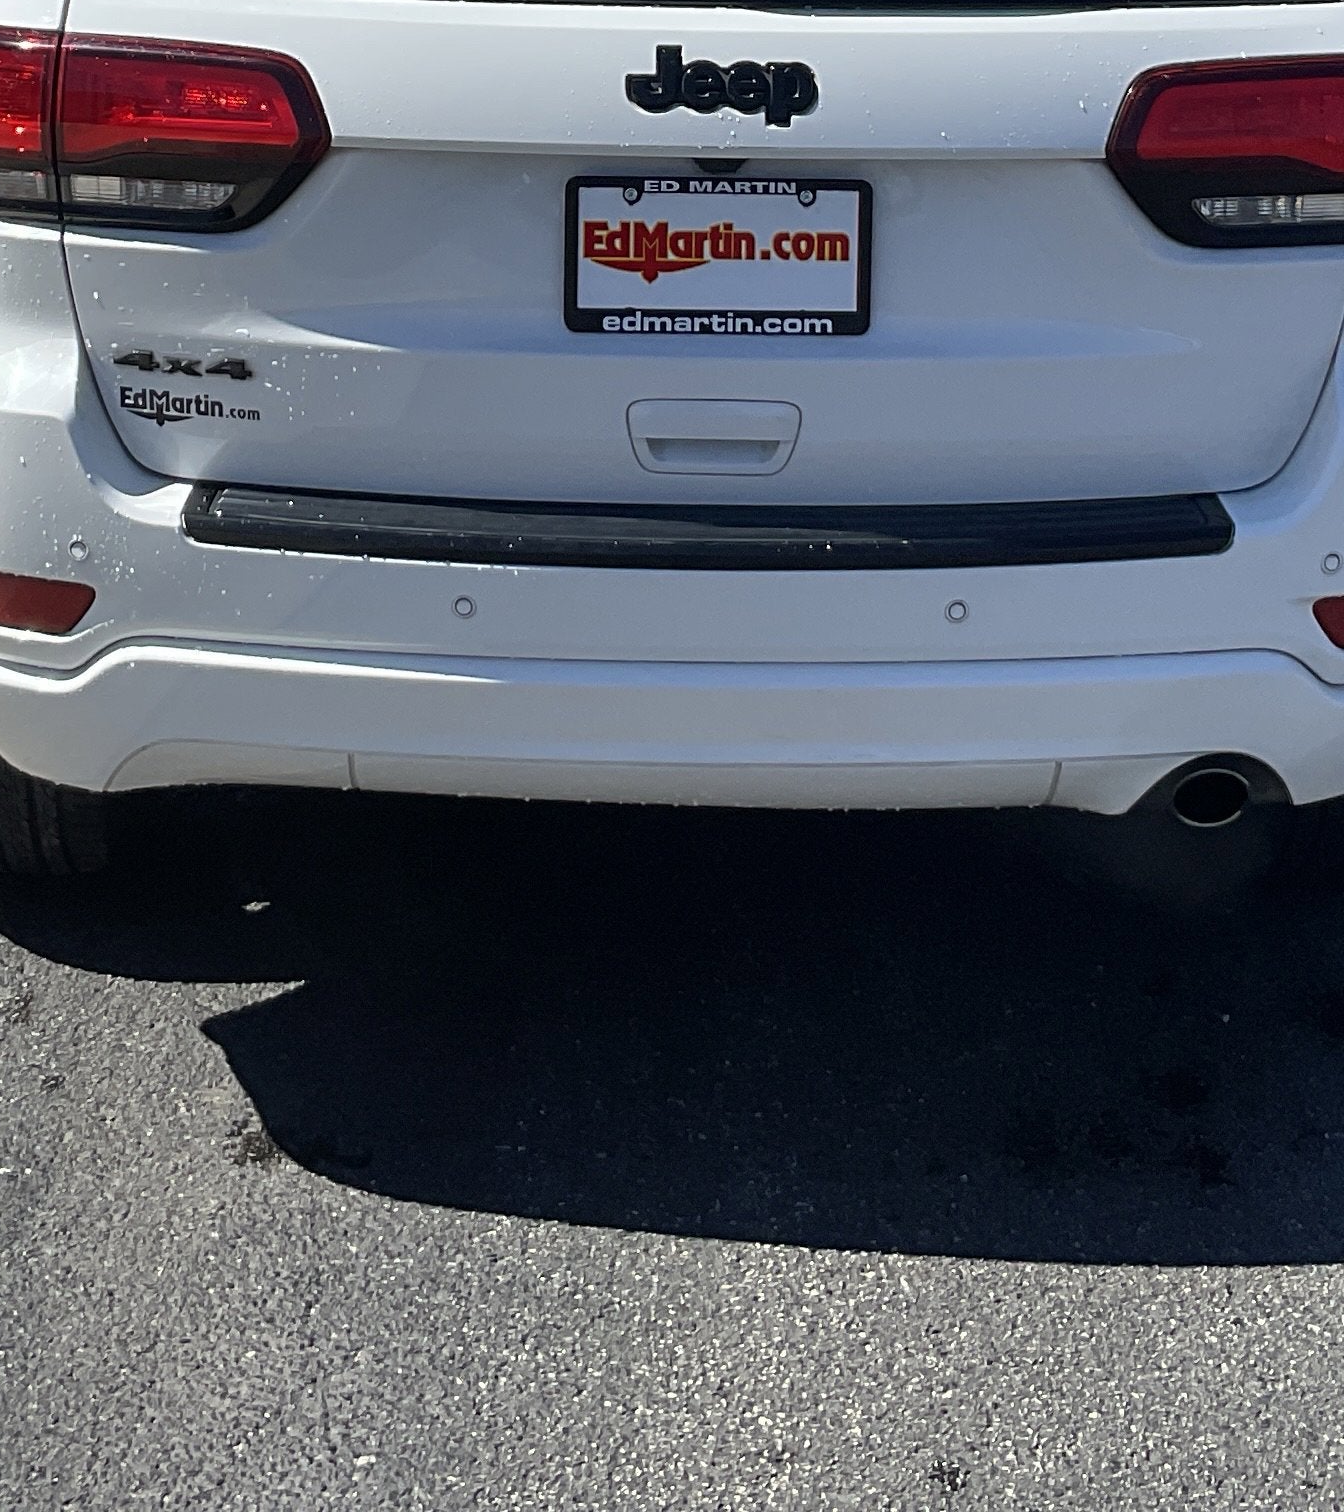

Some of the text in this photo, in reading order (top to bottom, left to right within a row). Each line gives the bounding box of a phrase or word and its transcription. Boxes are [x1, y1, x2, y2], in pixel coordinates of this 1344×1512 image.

[625, 44, 819, 128] Jeep
[643, 180, 797, 194] ED MARTIN
[583, 220, 850, 268] EdMartin.com
[602, 311, 833, 334] edmartin.com
[120, 386, 261, 424] EdMartin.com
